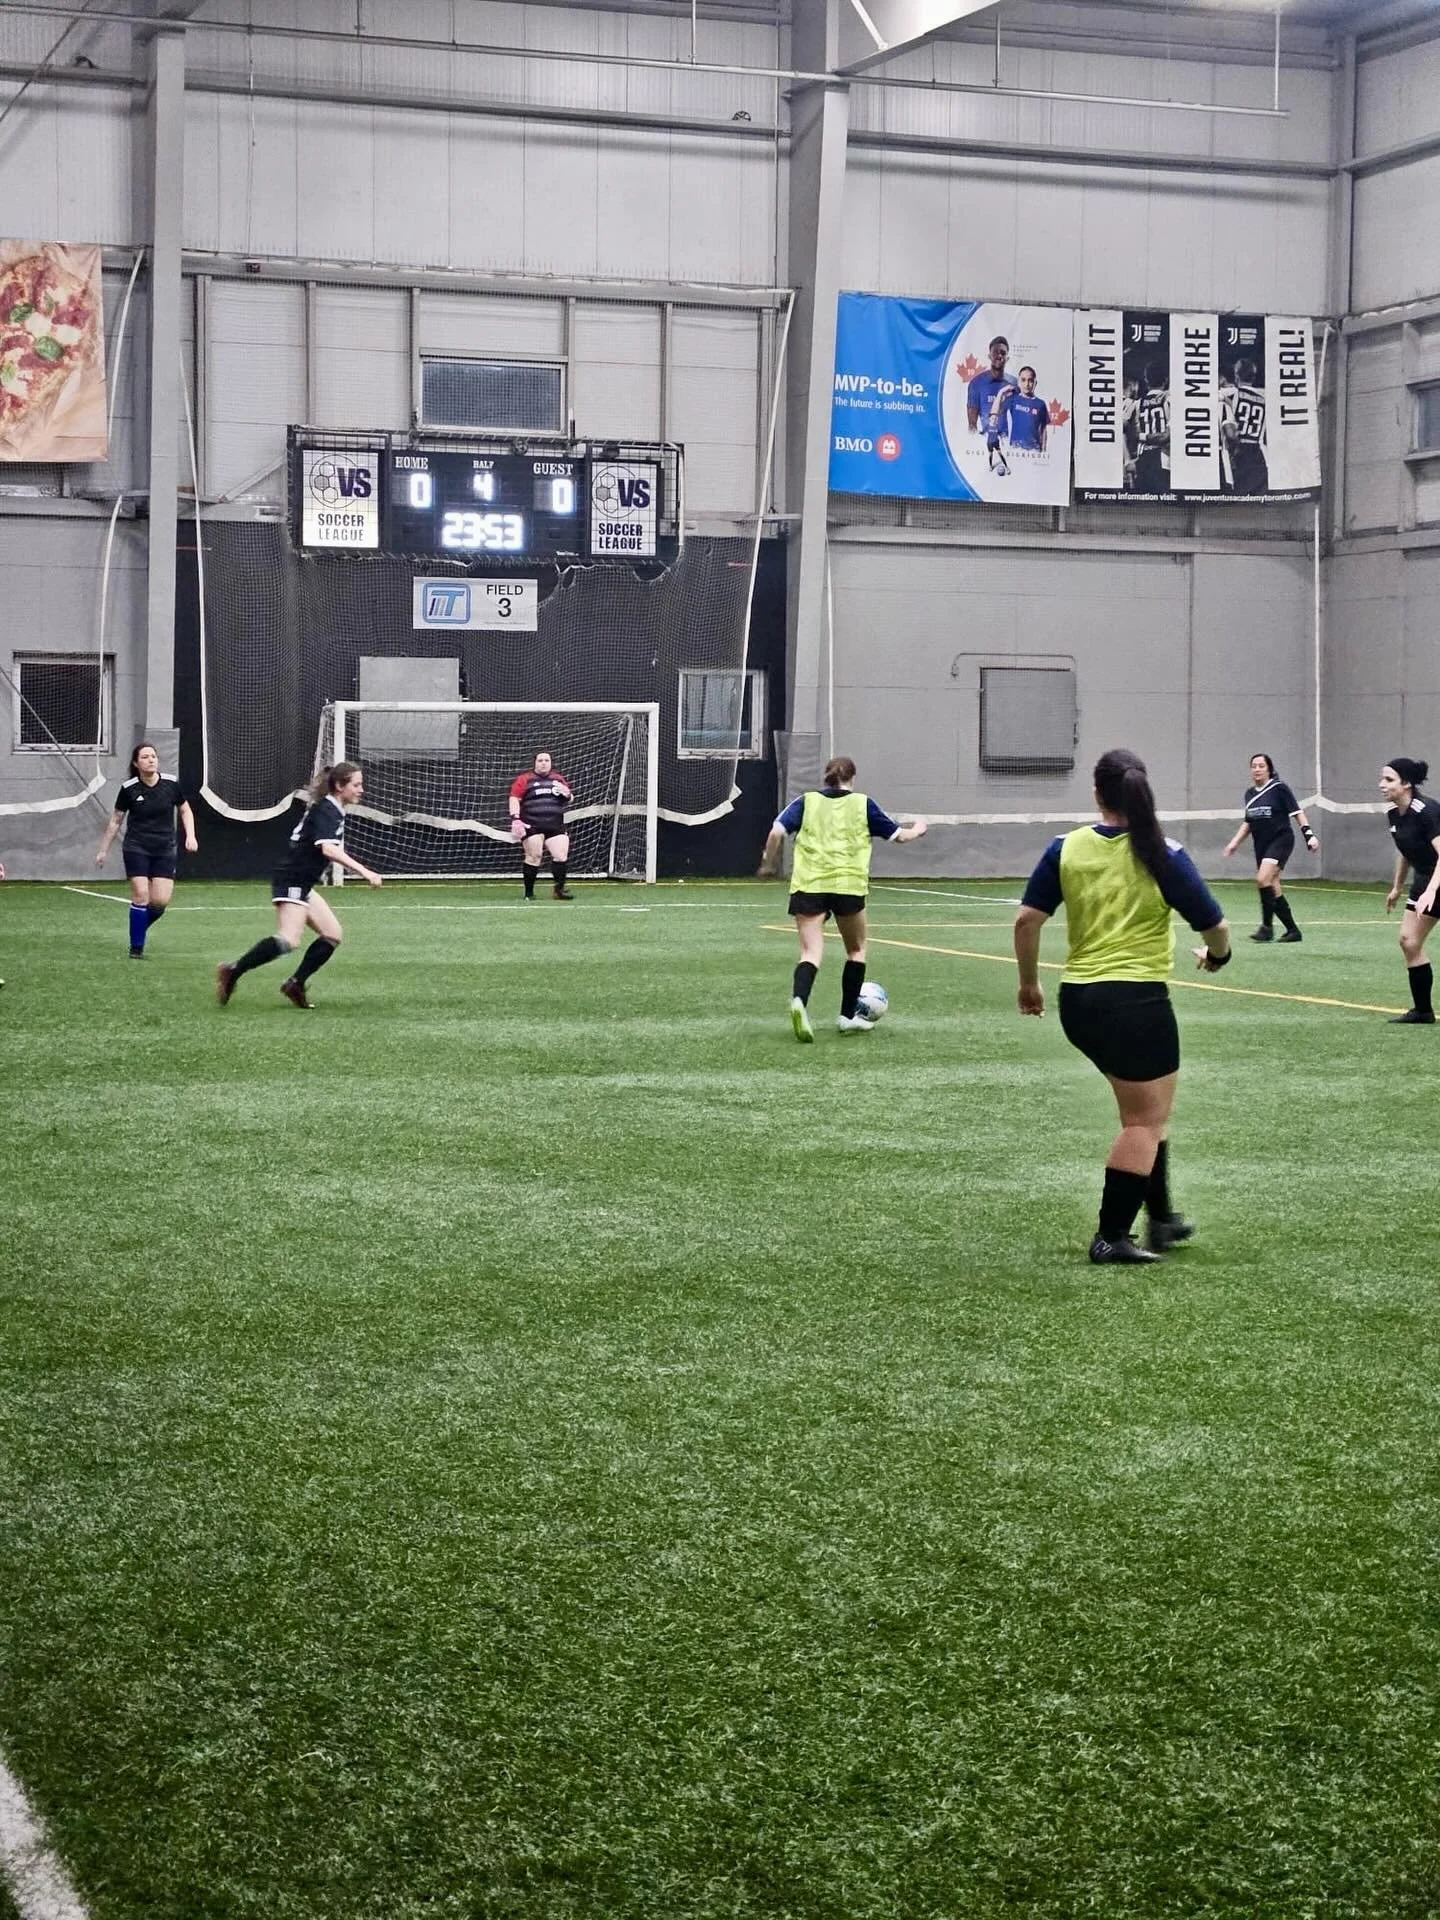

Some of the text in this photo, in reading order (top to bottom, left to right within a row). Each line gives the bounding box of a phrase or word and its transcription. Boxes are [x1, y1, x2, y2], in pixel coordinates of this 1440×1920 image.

[835, 374, 929, 397] MVP-to-be.
[1089, 323, 1116, 443] DREAM IT
[1279, 329, 1310, 426] IT REAL!
[1184, 327, 1211, 458] AND MAKE
[835, 396, 848, 407] The
[850, 397, 873, 409] future
[875, 399, 881, 410] is
[883, 400, 914, 414] subbing
[1237, 401, 1264, 437] 33
[834, 436, 873, 453] BMO
[395, 456, 429, 470] HOME
[472, 460, 495, 469] HALF
[533, 462, 574, 475] GUEST
[337, 467, 372, 498] VS
[410, 473, 432, 508] 0
[473, 473, 494, 502] 4
[551, 478, 574, 514] 0
[617, 478, 651, 509] VS
[1084, 491, 1097, 500] For
[1098, 492, 1116, 500] more
[1118, 492, 1159, 501] information
[318, 513, 365, 527] SOCCER
[598, 522, 643, 537] SOCCER
[319, 528, 364, 541] LEAGUE
[599, 537, 642, 550] LEAGUE
[486, 584, 524, 596] FIELD
[497, 597, 512, 618] 3
